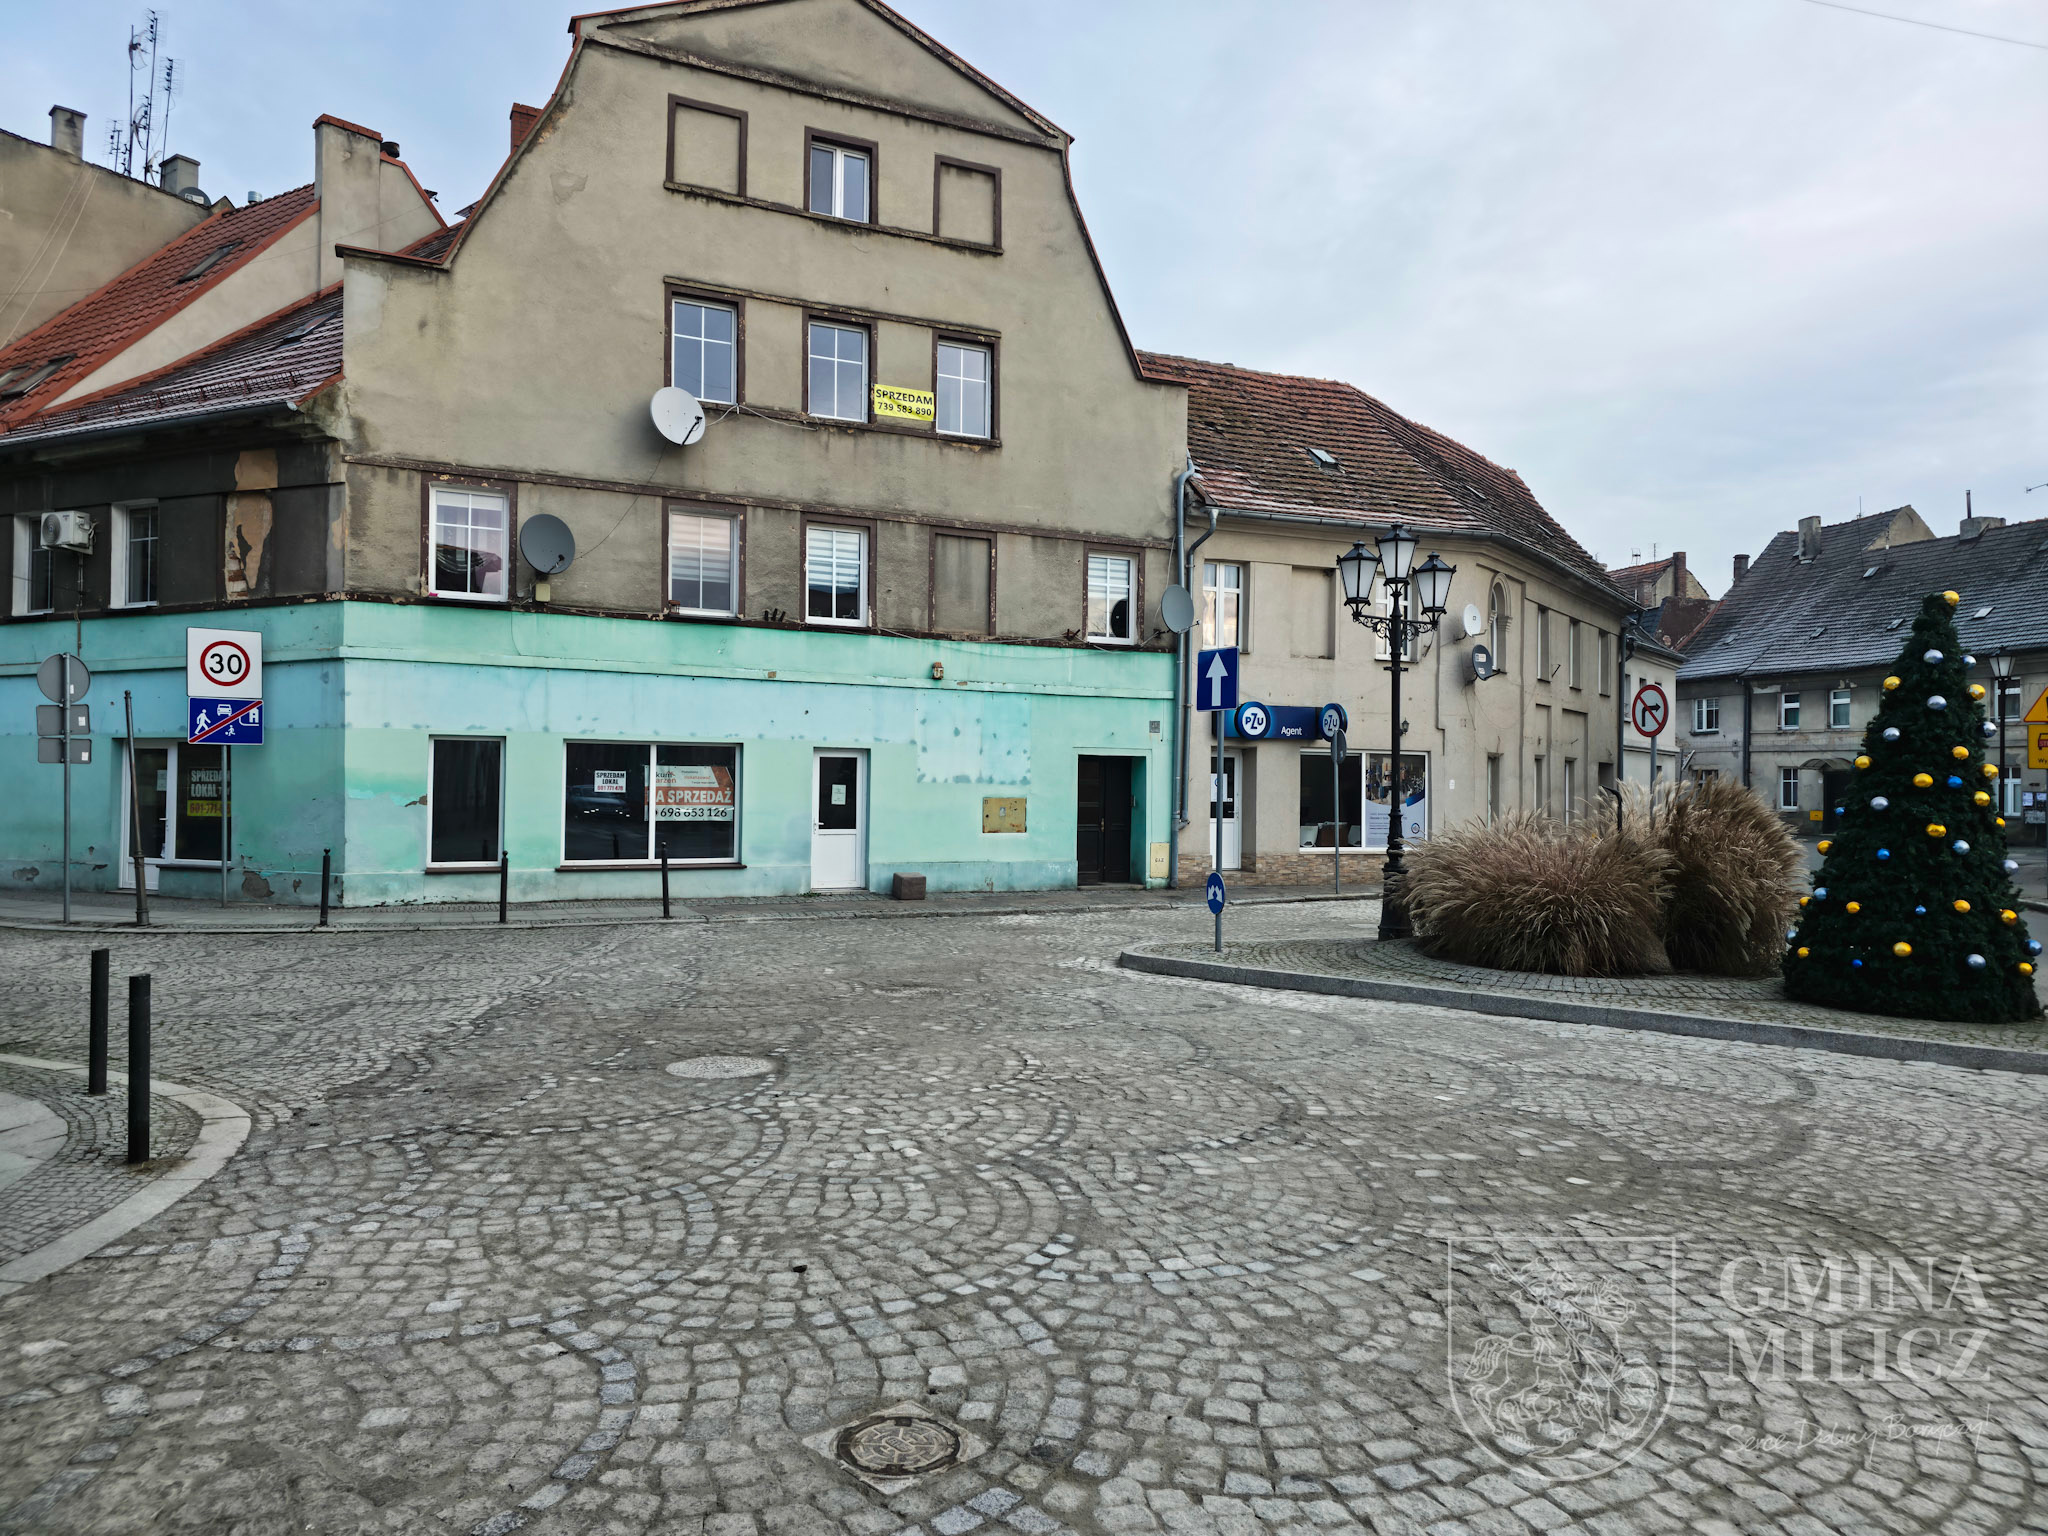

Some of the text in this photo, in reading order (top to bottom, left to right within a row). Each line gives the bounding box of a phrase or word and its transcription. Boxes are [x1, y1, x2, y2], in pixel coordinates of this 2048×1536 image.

[876, 389, 932, 405] SPRZEDAM
[877, 402, 931, 416] 739 583 890
[209, 653, 243, 675] 30
[1245, 713, 1264, 729] PZU
[1323, 714, 1338, 731] PZU
[1281, 726, 1302, 736] Agent
[190, 783, 217, 798] LOKAL
[667, 787, 732, 803] SPRZEDAŻ
[660, 807, 728, 817] 698 653 126
